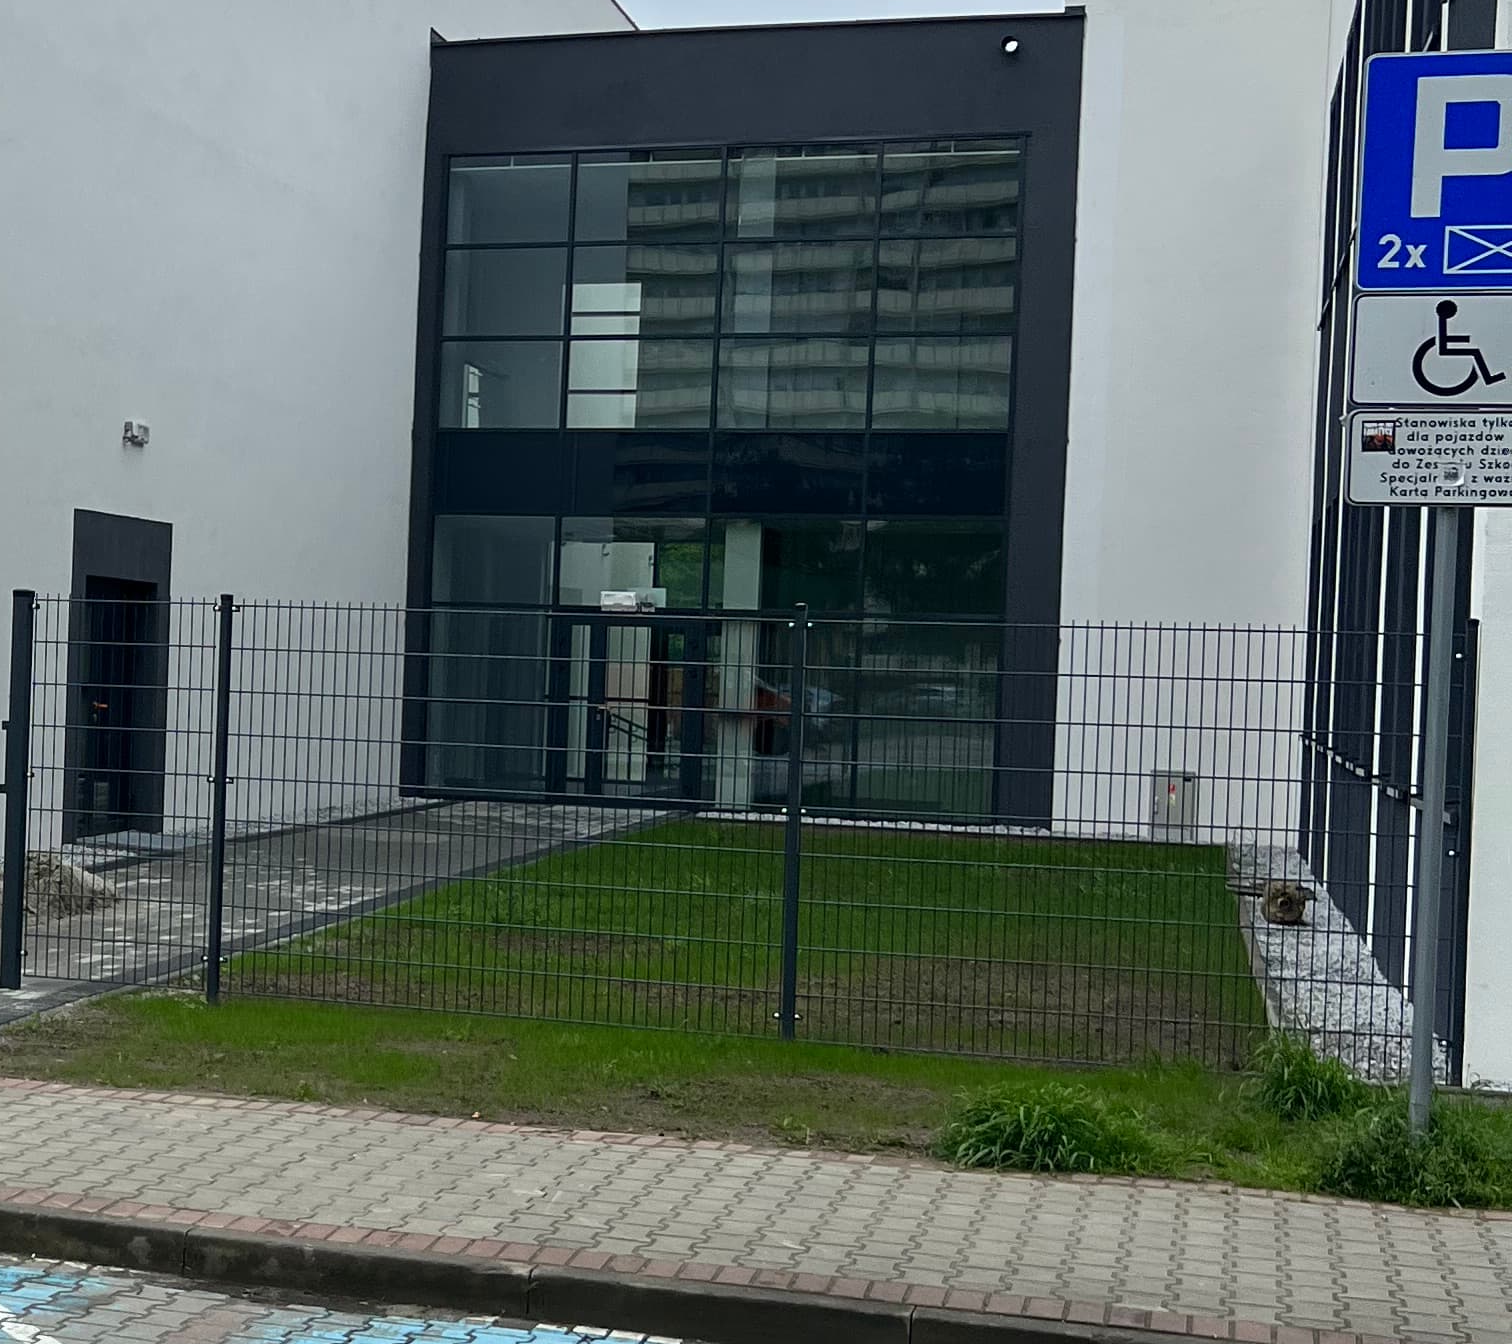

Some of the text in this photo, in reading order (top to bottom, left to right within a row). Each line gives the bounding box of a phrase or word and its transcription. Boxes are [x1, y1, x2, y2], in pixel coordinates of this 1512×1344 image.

[1410, 74, 1512, 218] P
[1377, 233, 1427, 269] 2x
[1396, 417, 1476, 428] Stanowiska
[1407, 431, 1429, 442] dla
[1392, 459, 1410, 469] do
[1479, 459, 1512, 469] Szko
[1471, 475, 1478, 483] z
